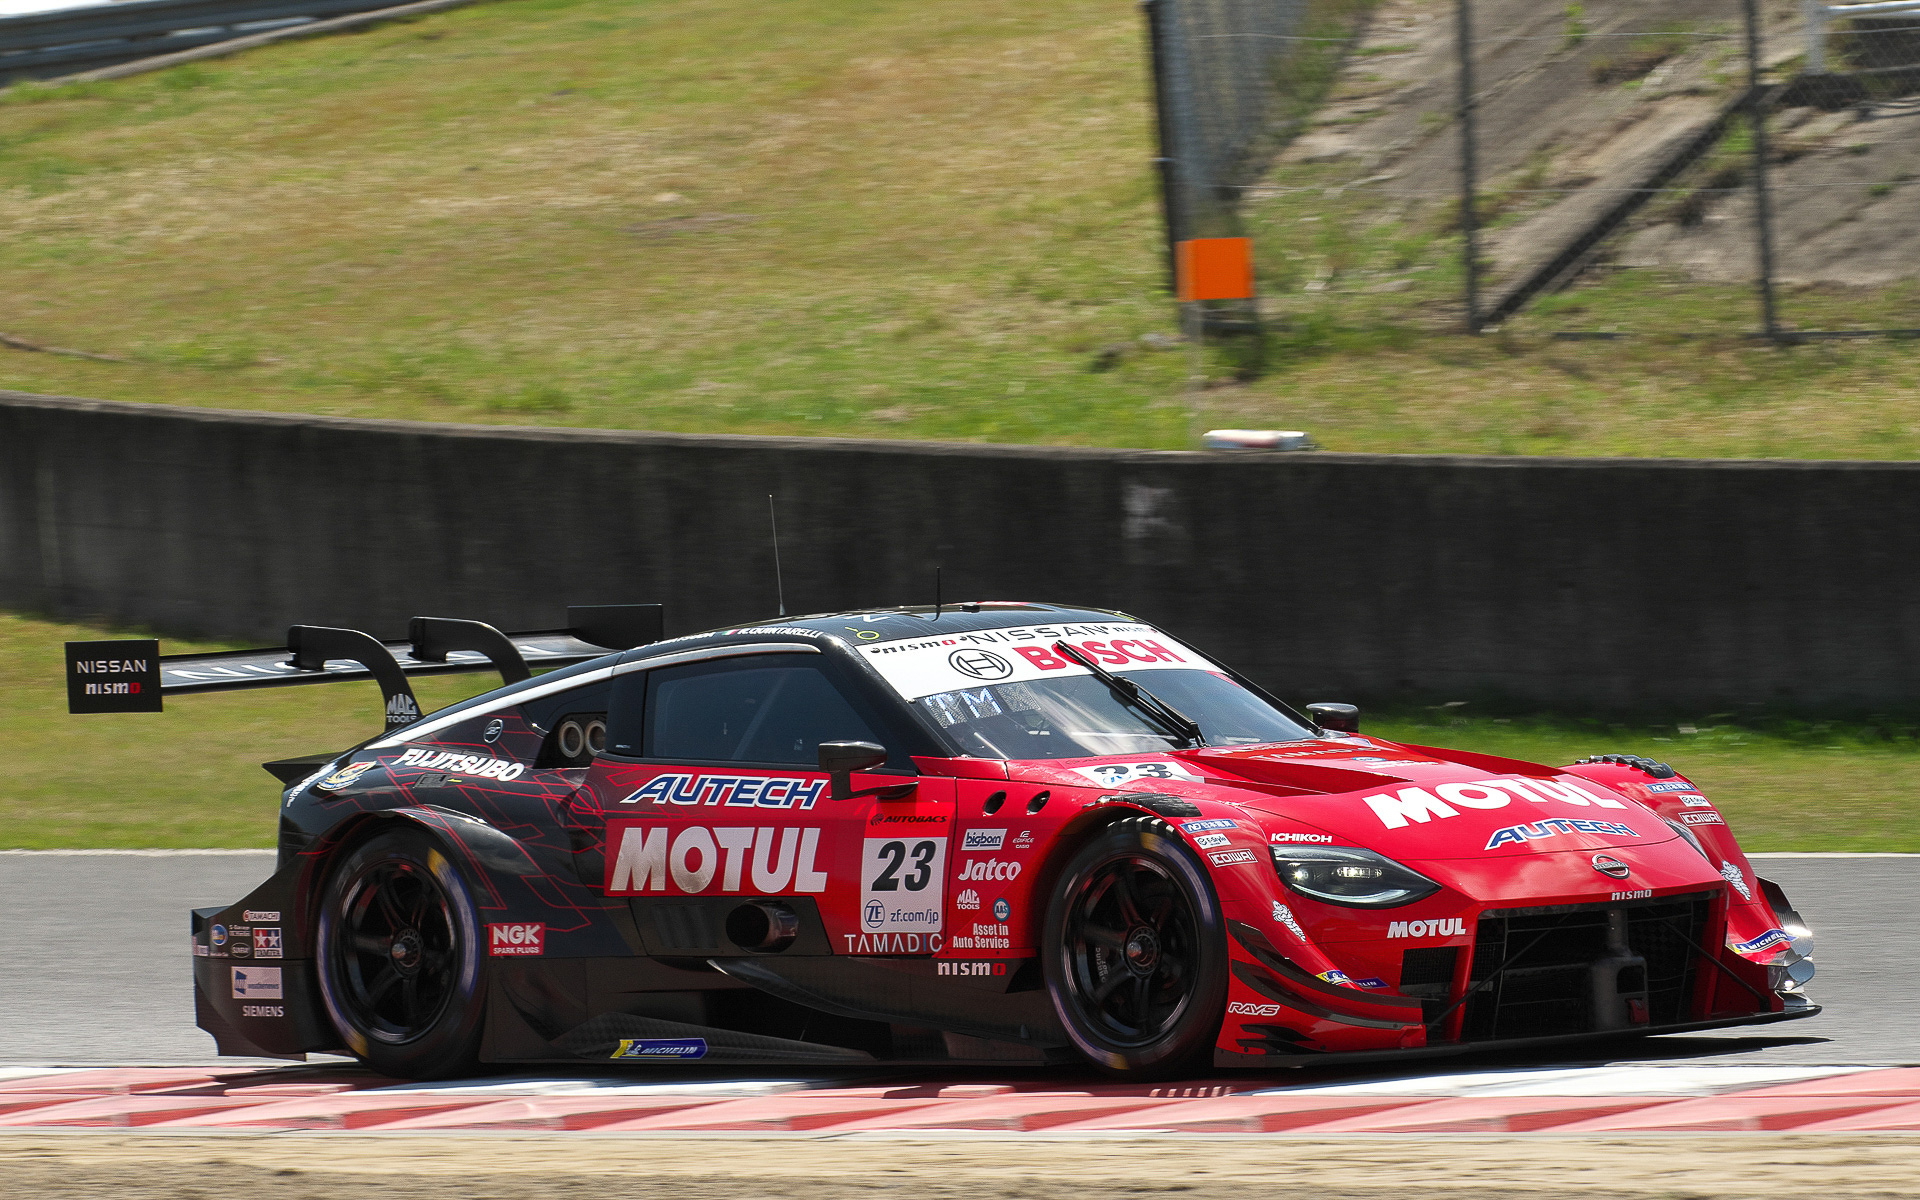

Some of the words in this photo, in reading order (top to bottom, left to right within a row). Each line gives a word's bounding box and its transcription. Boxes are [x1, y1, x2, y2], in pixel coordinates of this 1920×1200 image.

[966, 625, 1109, 645] NISSAN
[884, 640, 956, 654] nismo
[1012, 639, 1188, 671] BOSCH
[76, 659, 147, 674] NISSAN
[85, 682, 141, 695] nismo
[386, 693, 417, 715] MAC
[386, 715, 417, 723] TOOLS
[390, 748, 526, 782] FUJITSUBO
[619, 773, 830, 810] AUTECH
[1362, 774, 1629, 830] MOTUL
[884, 815, 948, 824] AUTOBACS
[1271, 833, 1333, 843] ICHIKOH
[1484, 817, 1641, 851] AUTECH
[610, 826, 828, 894] MOTUL
[871, 840, 937, 892] 23
[957, 857, 1022, 881] Jatco
[957, 888, 980, 904] MAC
[1611, 888, 1653, 901] nismo
[866, 905, 884, 922] ZF
[890, 909, 939, 925] zf.com/jp
[493, 924, 541, 945] NGK
[973, 922, 998, 936] Asset
[998, 923, 1009, 936] in
[1386, 918, 1467, 939] MOTUL
[843, 933, 943, 953] TAMADIC
[952, 935, 973, 949] Auto
[974, 935, 1010, 949] Service
[1748, 932, 1788, 950] MICHELIN
[516, 946, 540, 954] PLUGS
[937, 962, 1007, 976] nismo
[242, 1005, 284, 1018] SIEMENS
[1227, 1001, 1280, 1017] RAYS
[641, 1046, 699, 1054] MICHELIN
